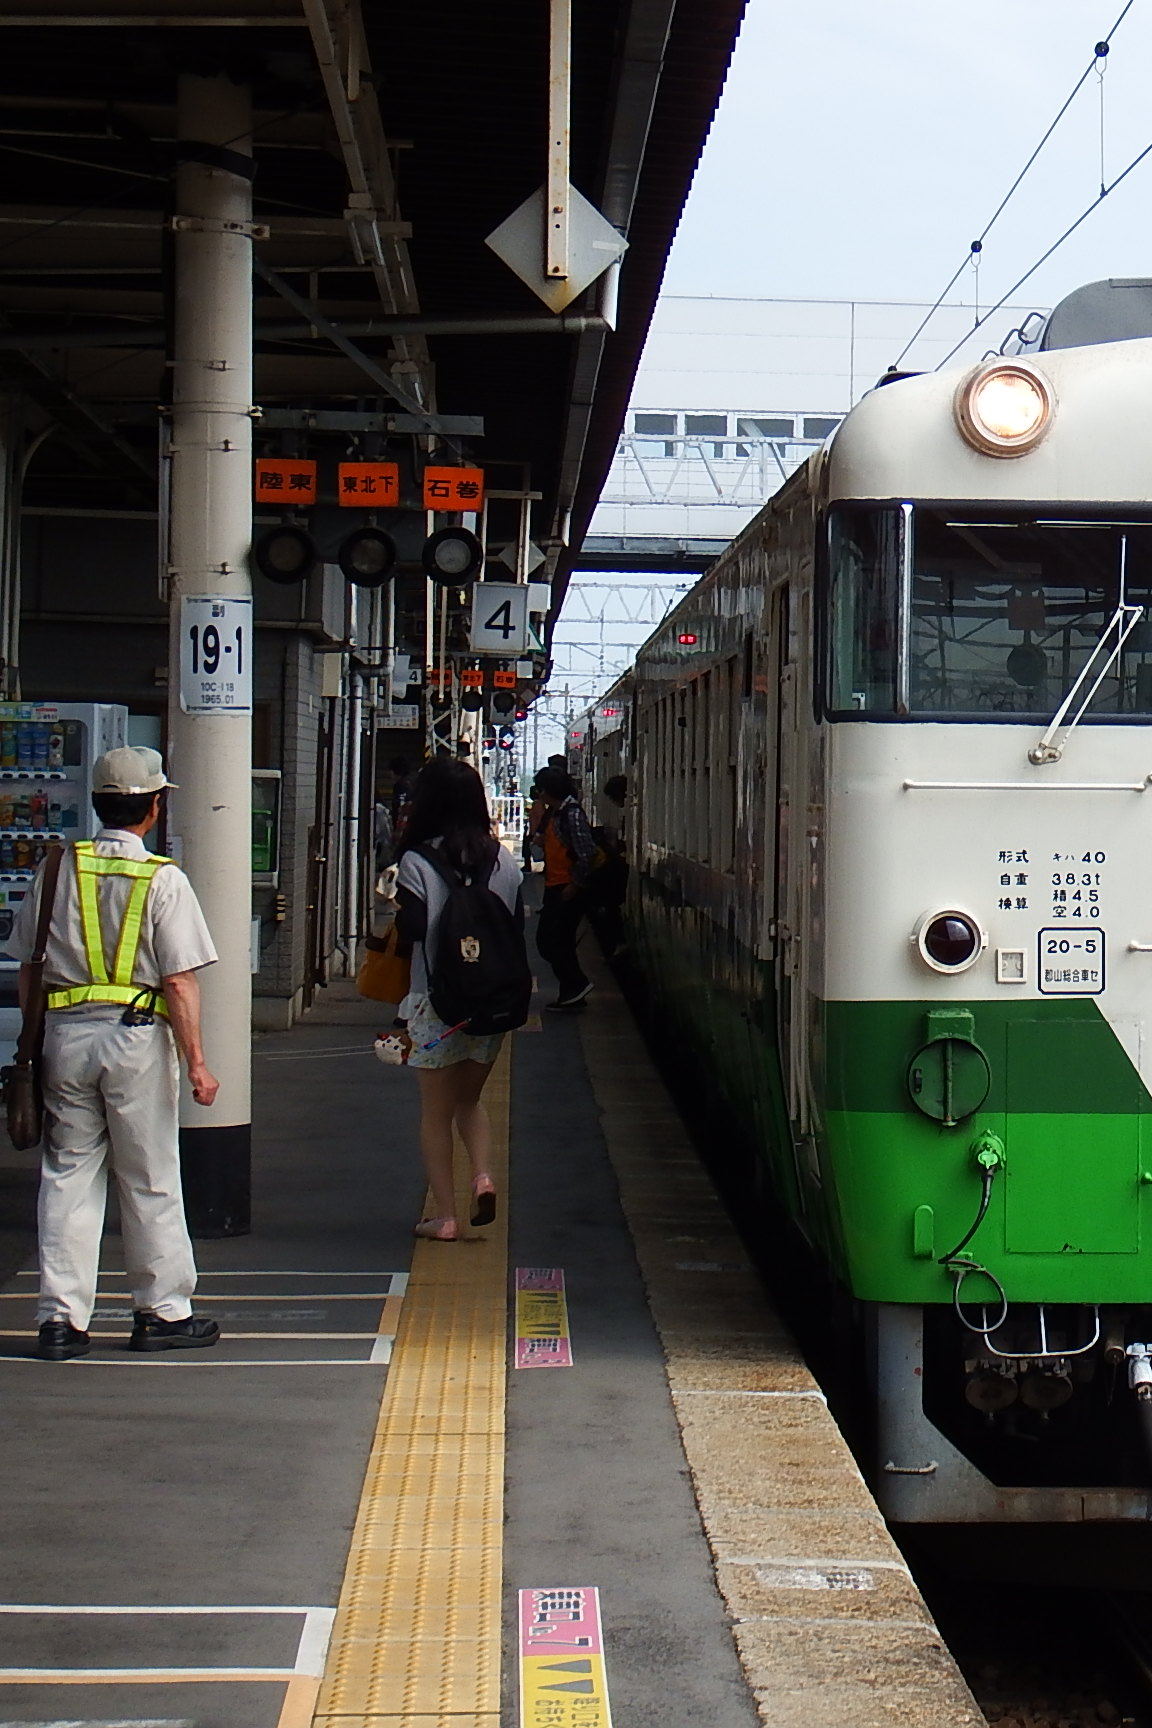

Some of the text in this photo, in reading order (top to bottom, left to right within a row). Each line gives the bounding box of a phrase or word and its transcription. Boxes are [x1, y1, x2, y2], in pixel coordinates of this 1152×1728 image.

[259, 471, 313, 491] 陸東
[342, 475, 394, 494] 東北下
[427, 478, 481, 499] 石巻
[484, 599, 516, 640] 4
[189, 624, 243, 675] 19-1
[409, 670, 418, 683] 4
[998, 849, 1029, 864] 形式
[1000, 872, 1101, 886] 自重 38.3t
[998, 896, 1029, 910] 換算
[1046, 939, 1097, 954] 20-5
[1044, 968, 1099, 983] 郡山総合車セ
